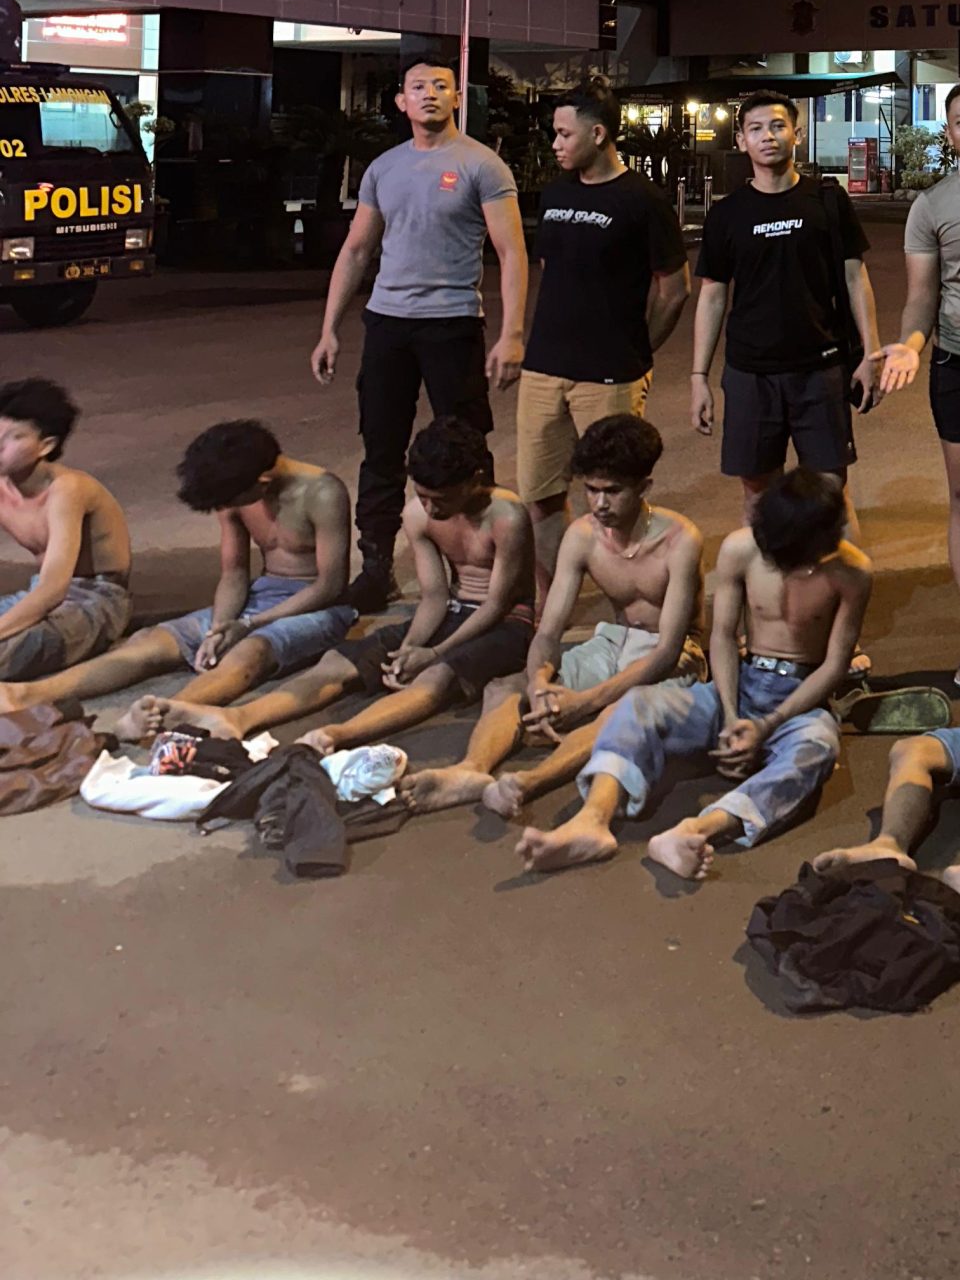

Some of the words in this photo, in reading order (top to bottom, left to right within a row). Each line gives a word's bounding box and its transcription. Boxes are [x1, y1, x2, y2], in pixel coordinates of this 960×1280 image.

[24, 183, 143, 221] POLISI
[56, 222, 117, 234] MITSUBISHI
[753, 218, 803, 235] REKONFU
